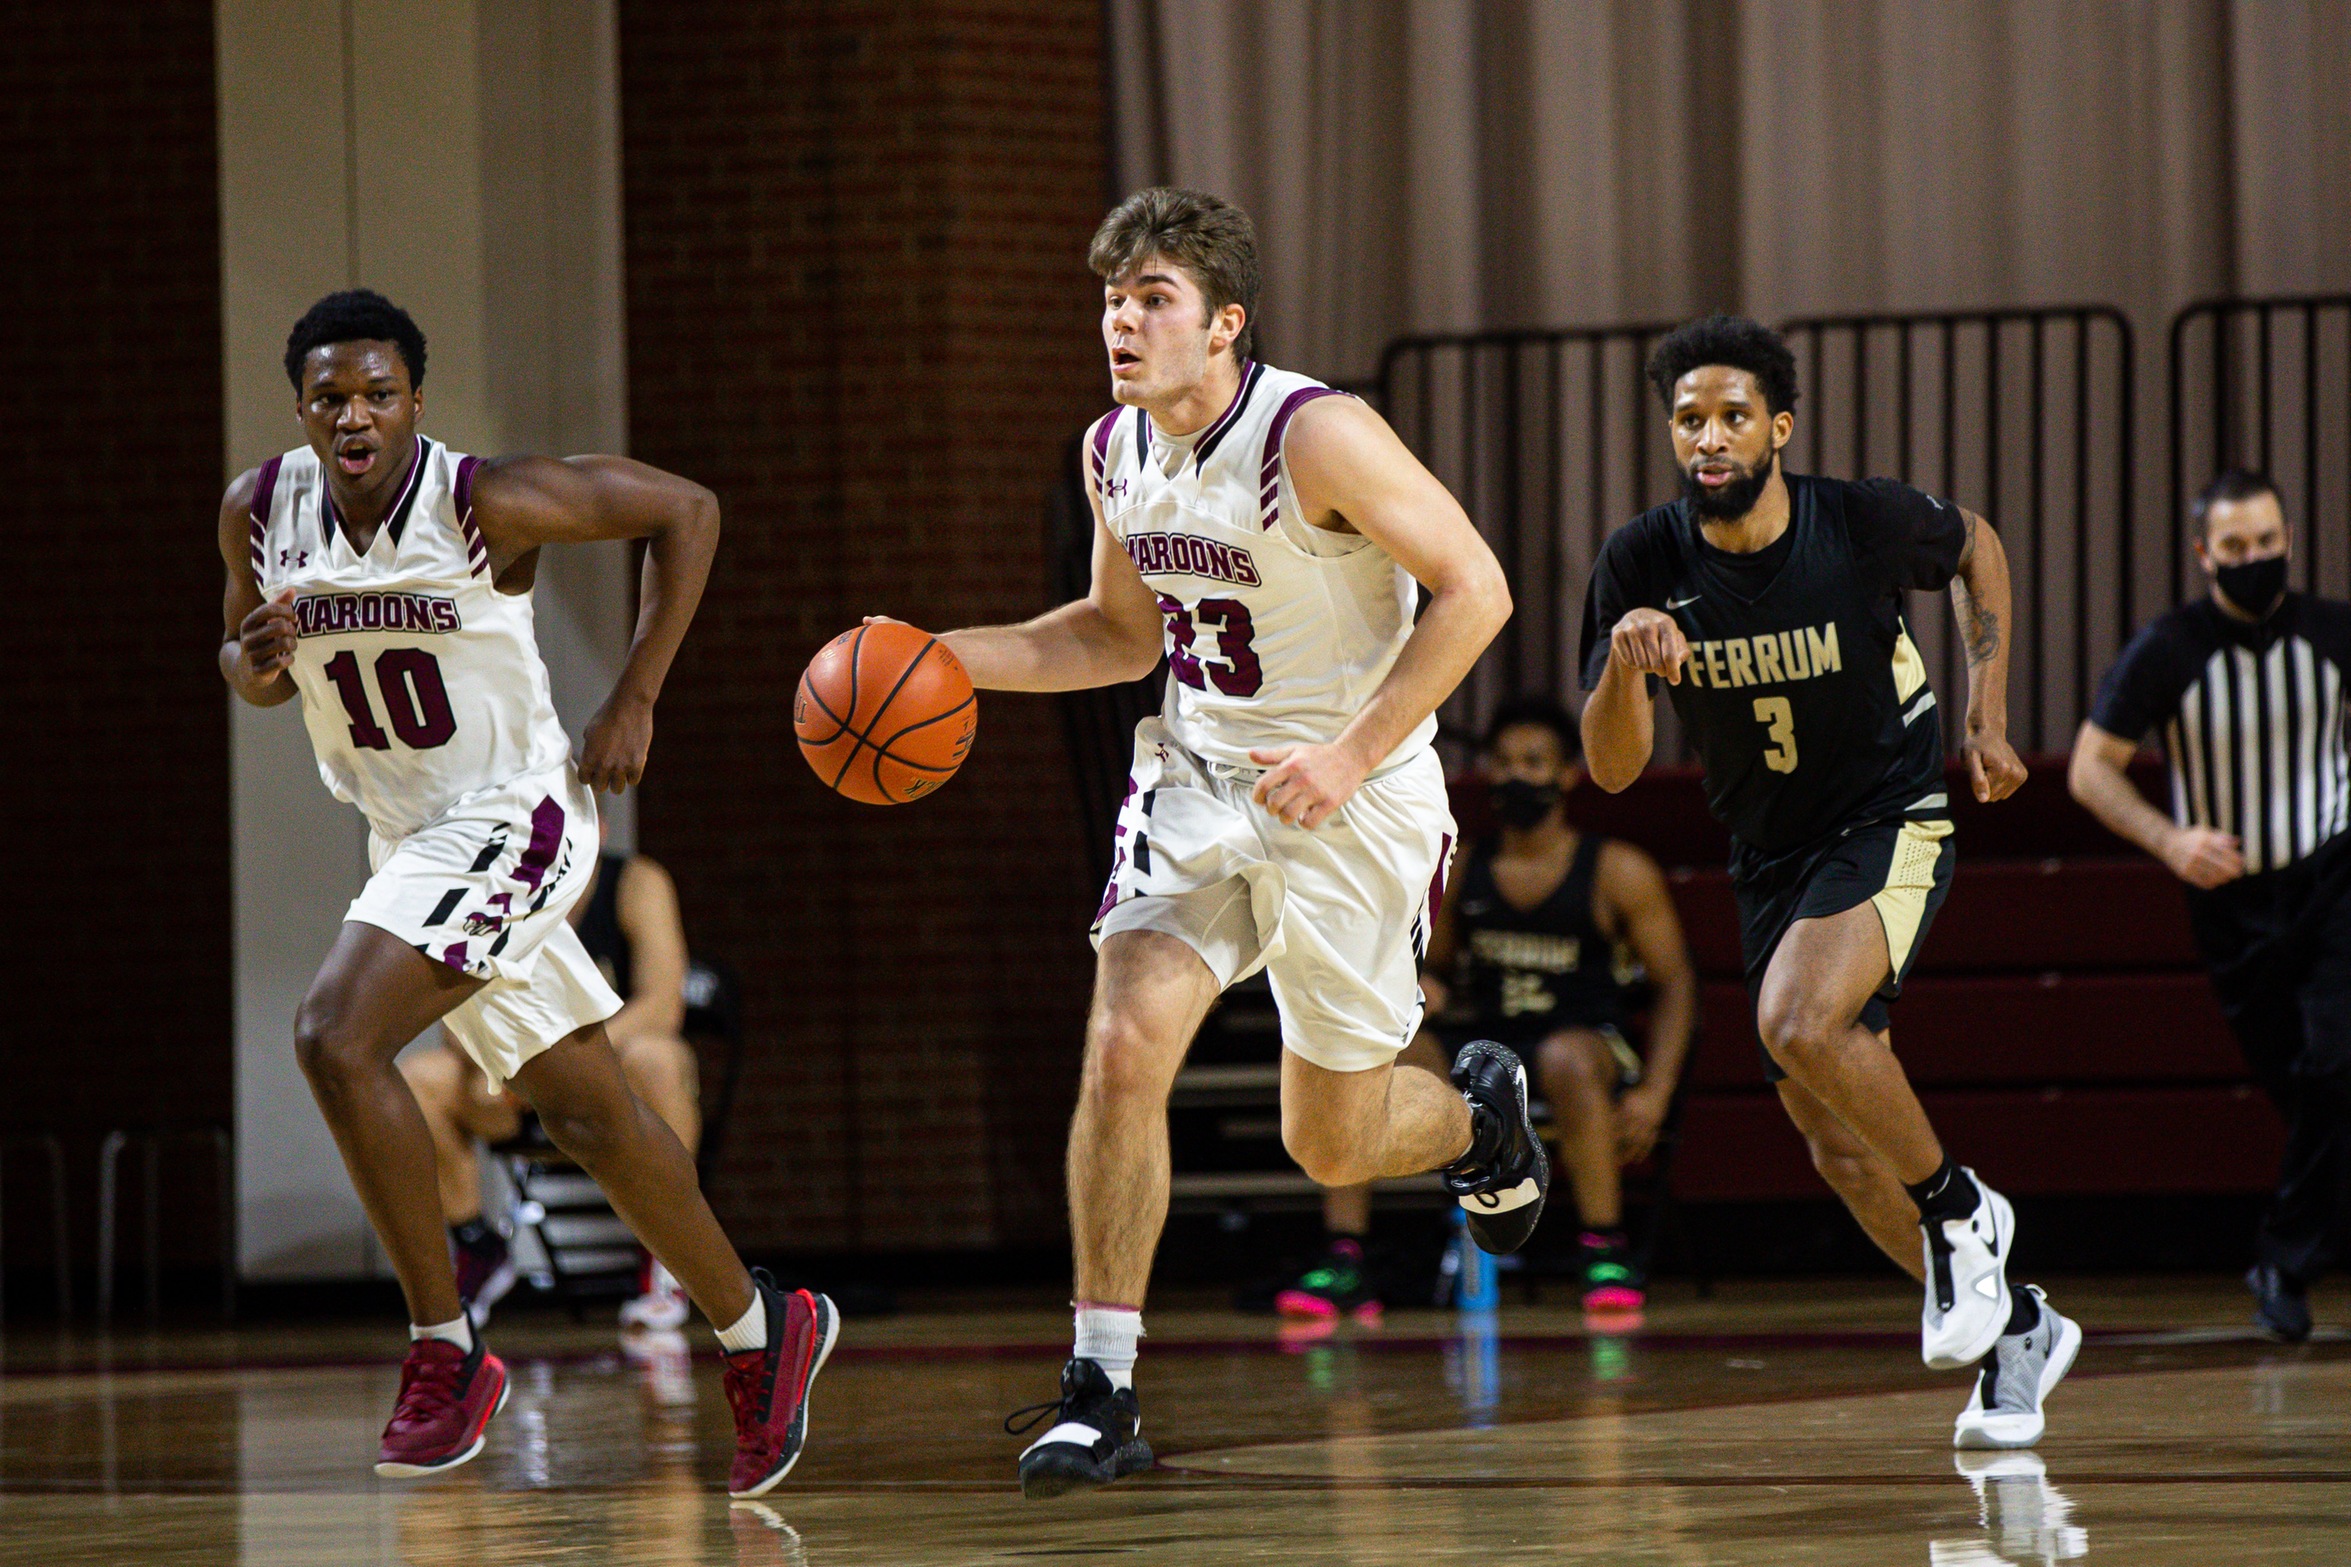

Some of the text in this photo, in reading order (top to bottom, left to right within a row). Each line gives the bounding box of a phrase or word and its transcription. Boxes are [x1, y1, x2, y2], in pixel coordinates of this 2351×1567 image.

[1686, 621, 1842, 689] FERRUM
[323, 647, 457, 751] 10
[1752, 696, 1799, 775] 3
